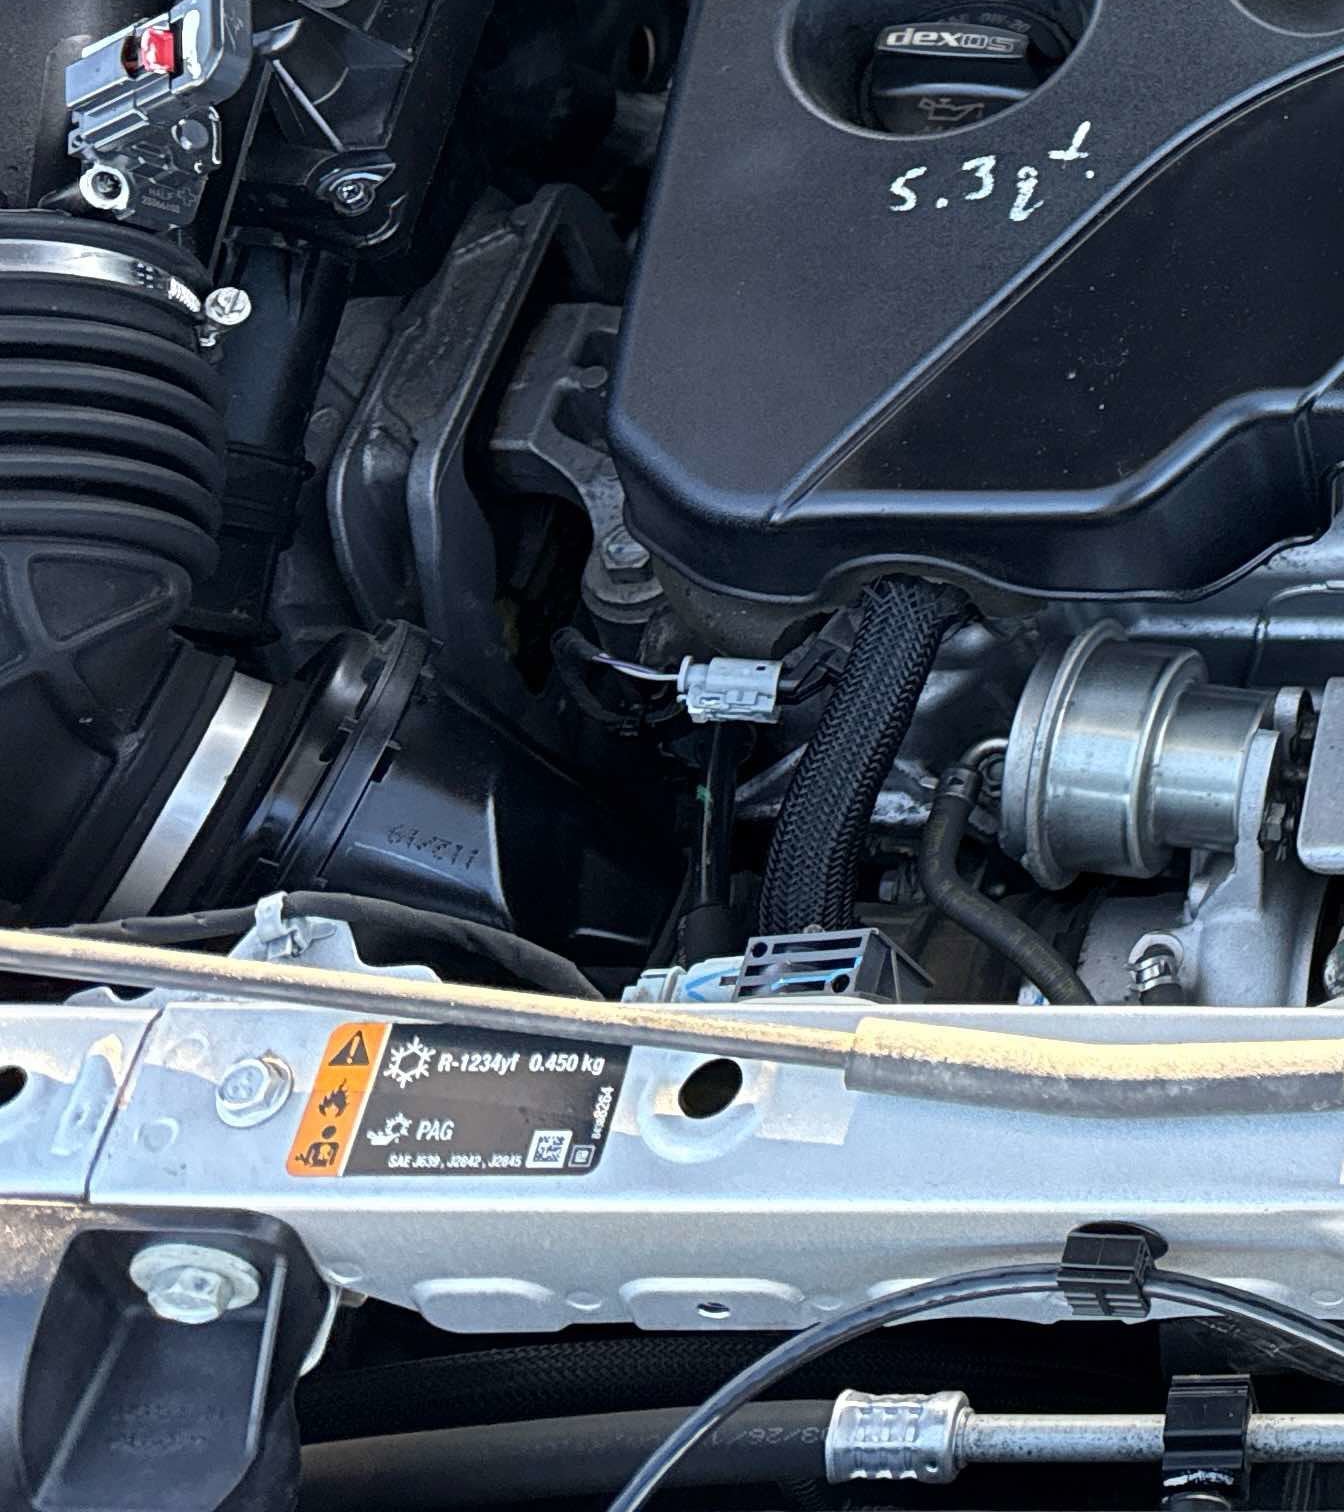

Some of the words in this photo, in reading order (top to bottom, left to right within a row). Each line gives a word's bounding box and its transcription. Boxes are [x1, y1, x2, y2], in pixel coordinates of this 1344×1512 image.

[886, 27, 1017, 53] dexos
[889, 155, 996, 212] 5.3
[438, 1054, 520, 1076] R-1234yf
[529, 1055, 578, 1073] 0.450
[582, 1054, 605, 1077] kg
[416, 1120, 455, 1141] PAG
[388, 1154, 411, 1168] SAE
